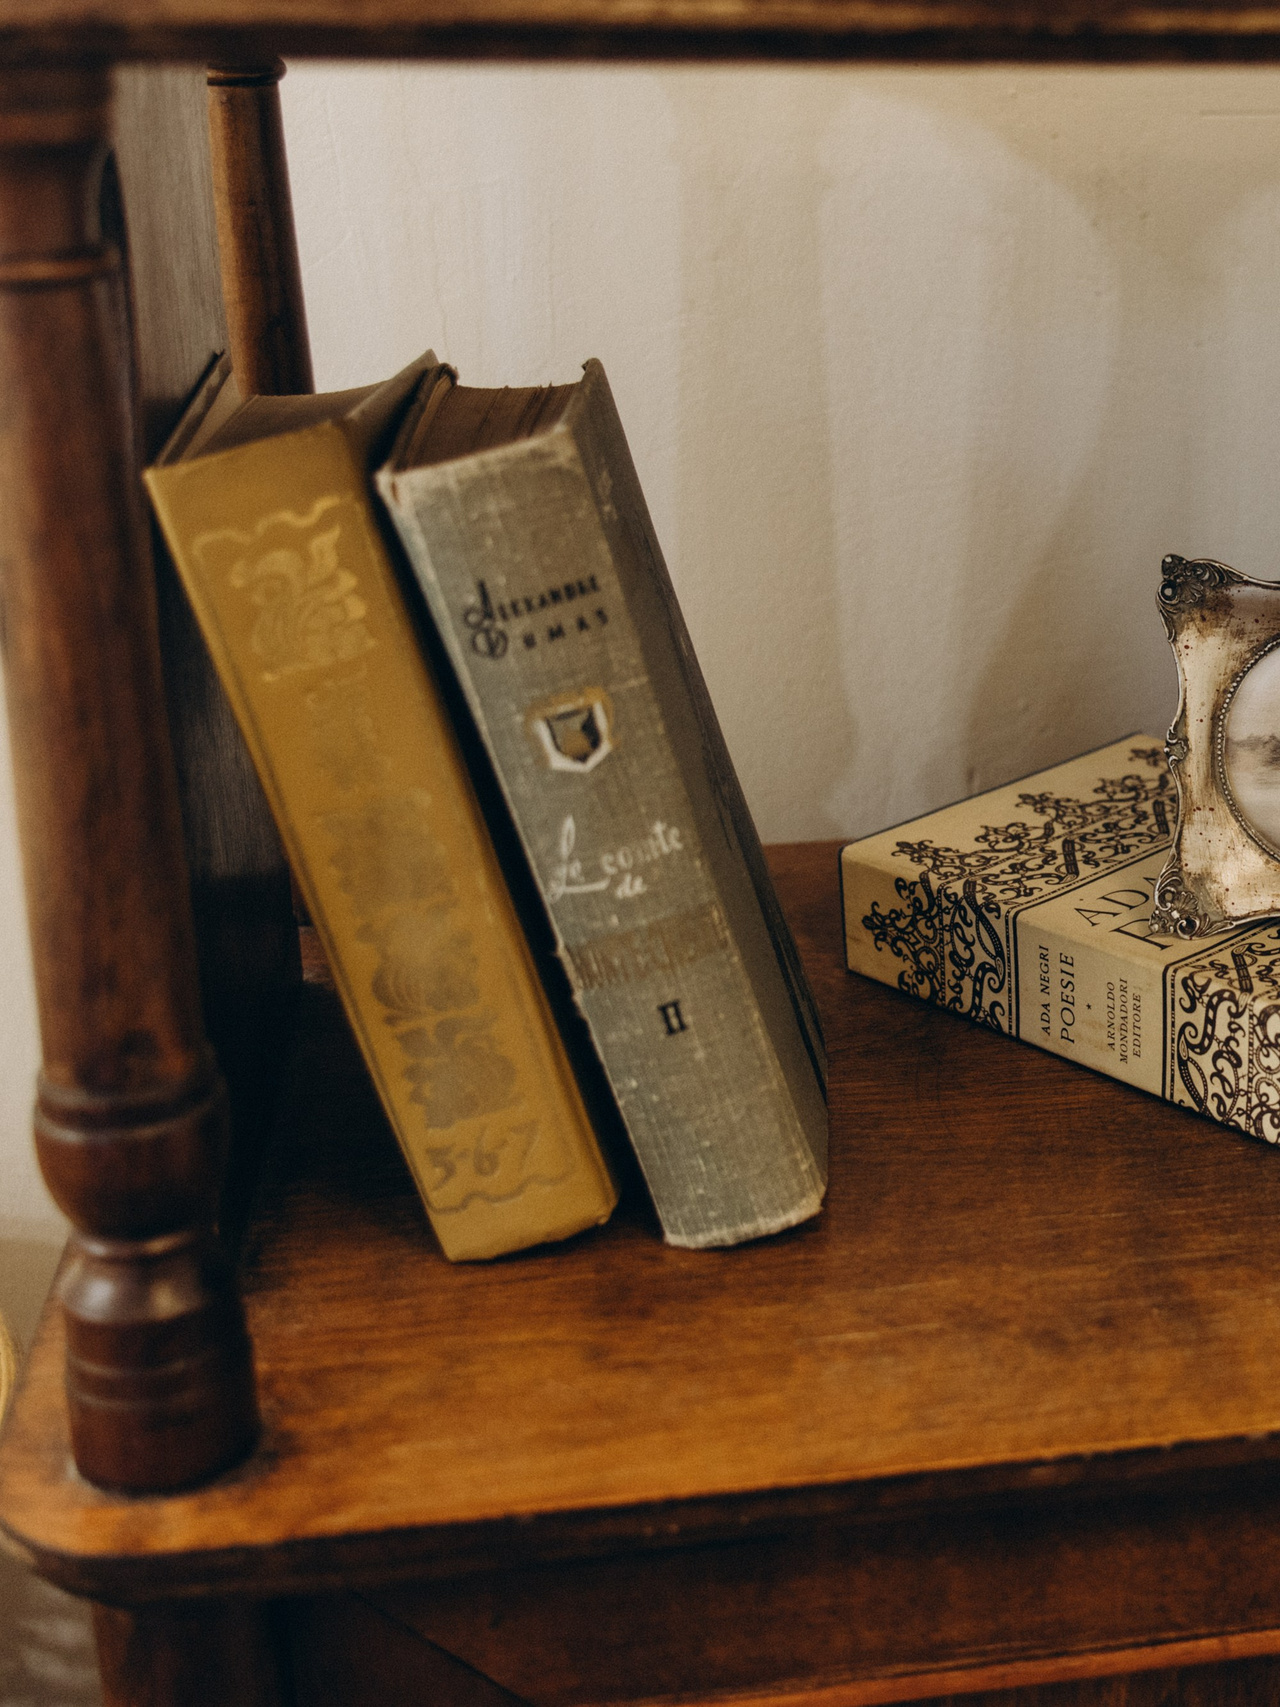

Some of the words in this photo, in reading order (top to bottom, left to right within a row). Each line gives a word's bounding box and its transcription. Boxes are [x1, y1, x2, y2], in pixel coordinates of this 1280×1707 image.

[549, 815, 611, 903] Le
[614, 873, 648, 900] de
[1038, 944, 1050, 996] NEGRI
[1059, 952, 1076, 1044] POESIE
[657, 999, 688, 1036] II
[1040, 1002, 1051, 1036] ADA
[1106, 981, 1116, 1051] ARNOLDO
[1119, 977, 1128, 1064] MONDADORI
[1132, 993, 1142, 1058] EDITORE
